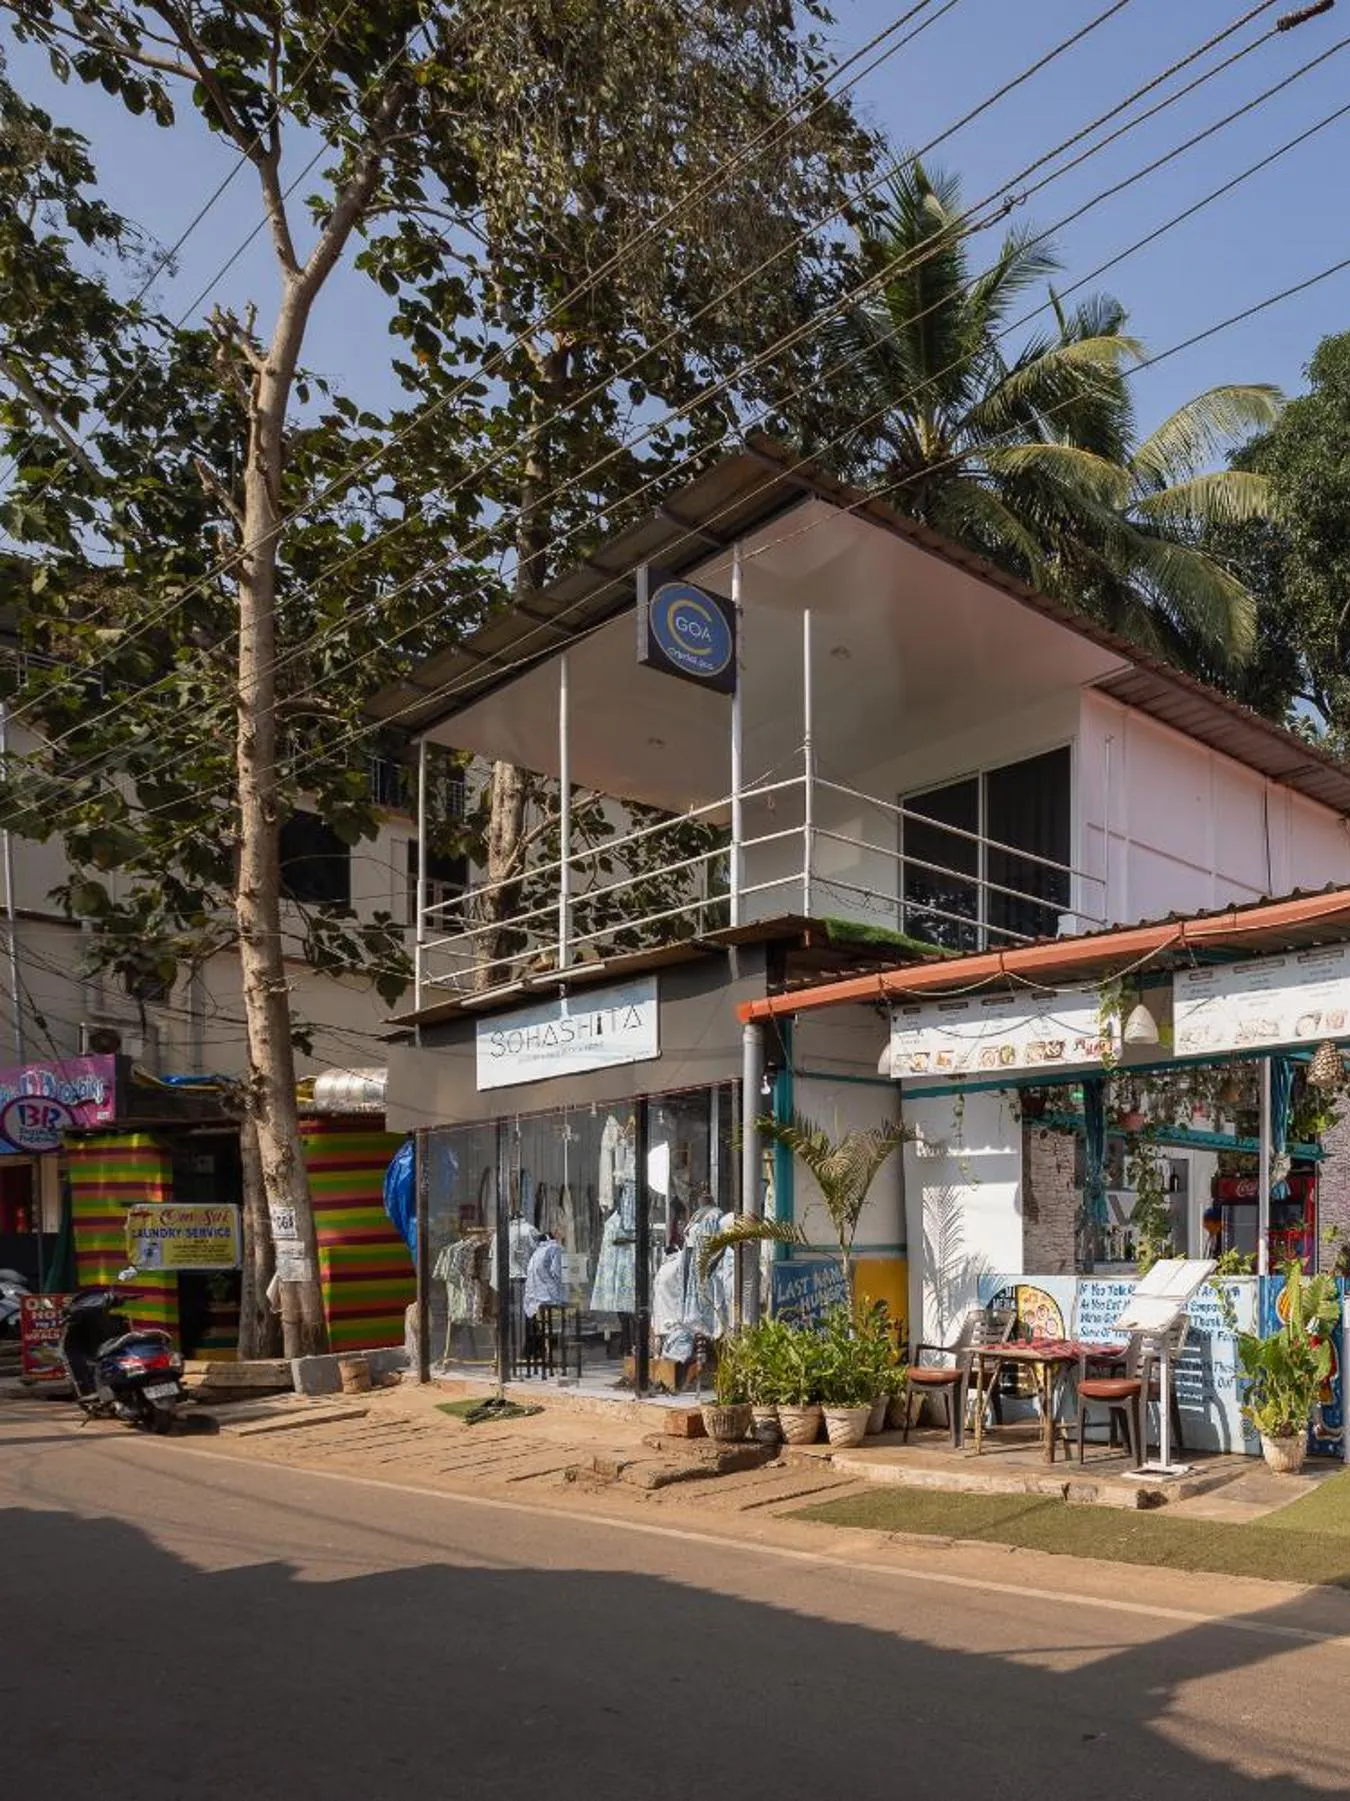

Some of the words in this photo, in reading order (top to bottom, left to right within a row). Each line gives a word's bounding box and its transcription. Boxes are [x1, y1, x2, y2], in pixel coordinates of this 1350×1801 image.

[490, 1004, 643, 1059] SOHASHITA
[132, 1227, 182, 1239] LAUNDRY
[185, 1226, 232, 1239] SERVICE
[777, 1276, 811, 1304] LAST
